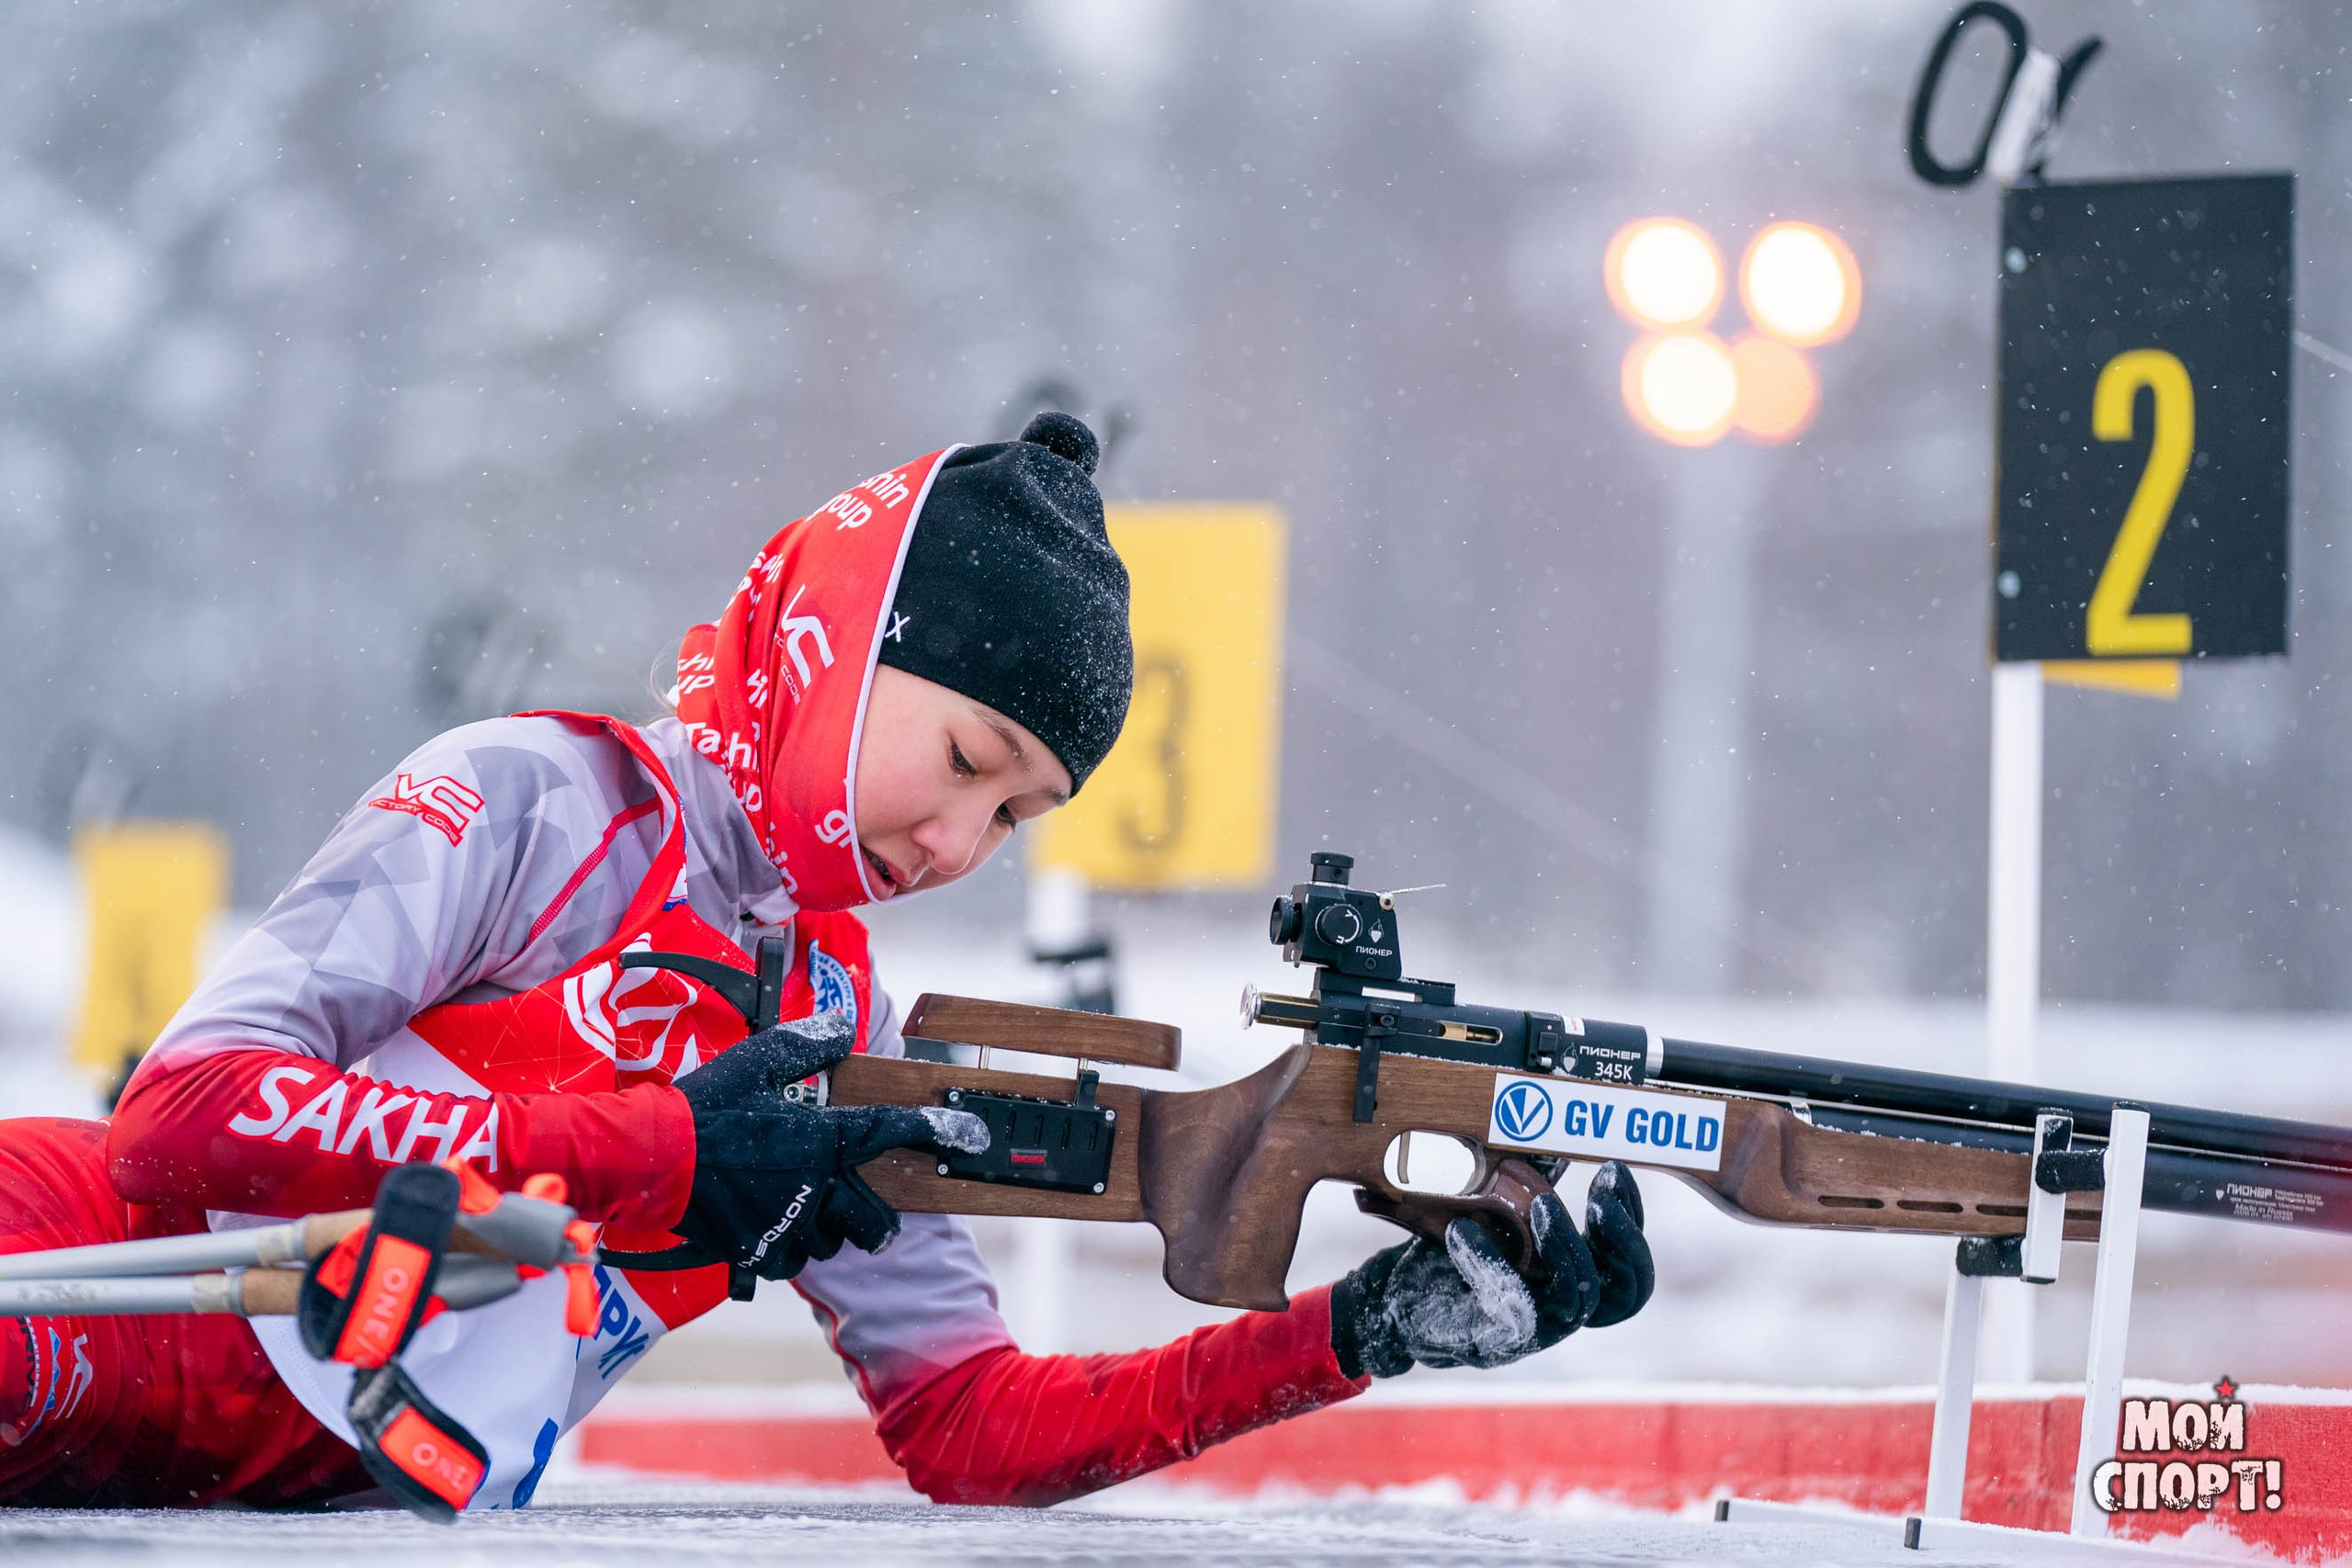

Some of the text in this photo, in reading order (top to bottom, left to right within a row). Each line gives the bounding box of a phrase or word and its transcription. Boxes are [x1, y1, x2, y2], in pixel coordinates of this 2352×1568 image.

[2086, 348, 2195, 655] 2
[1115, 648, 1191, 855] 3
[424, 813, 459, 841] CODE
[1356, 945, 1393, 957] ПИОНЕР
[1579, 1045, 1641, 1061] ПИОНЕР
[228, 1066, 499, 1173] SAKHA
[1564, 1100, 1719, 1152] GV GOLD
[2227, 1182, 2273, 1200] ПИОНЕР
[738, 1184, 812, 1268] NORDSKI
